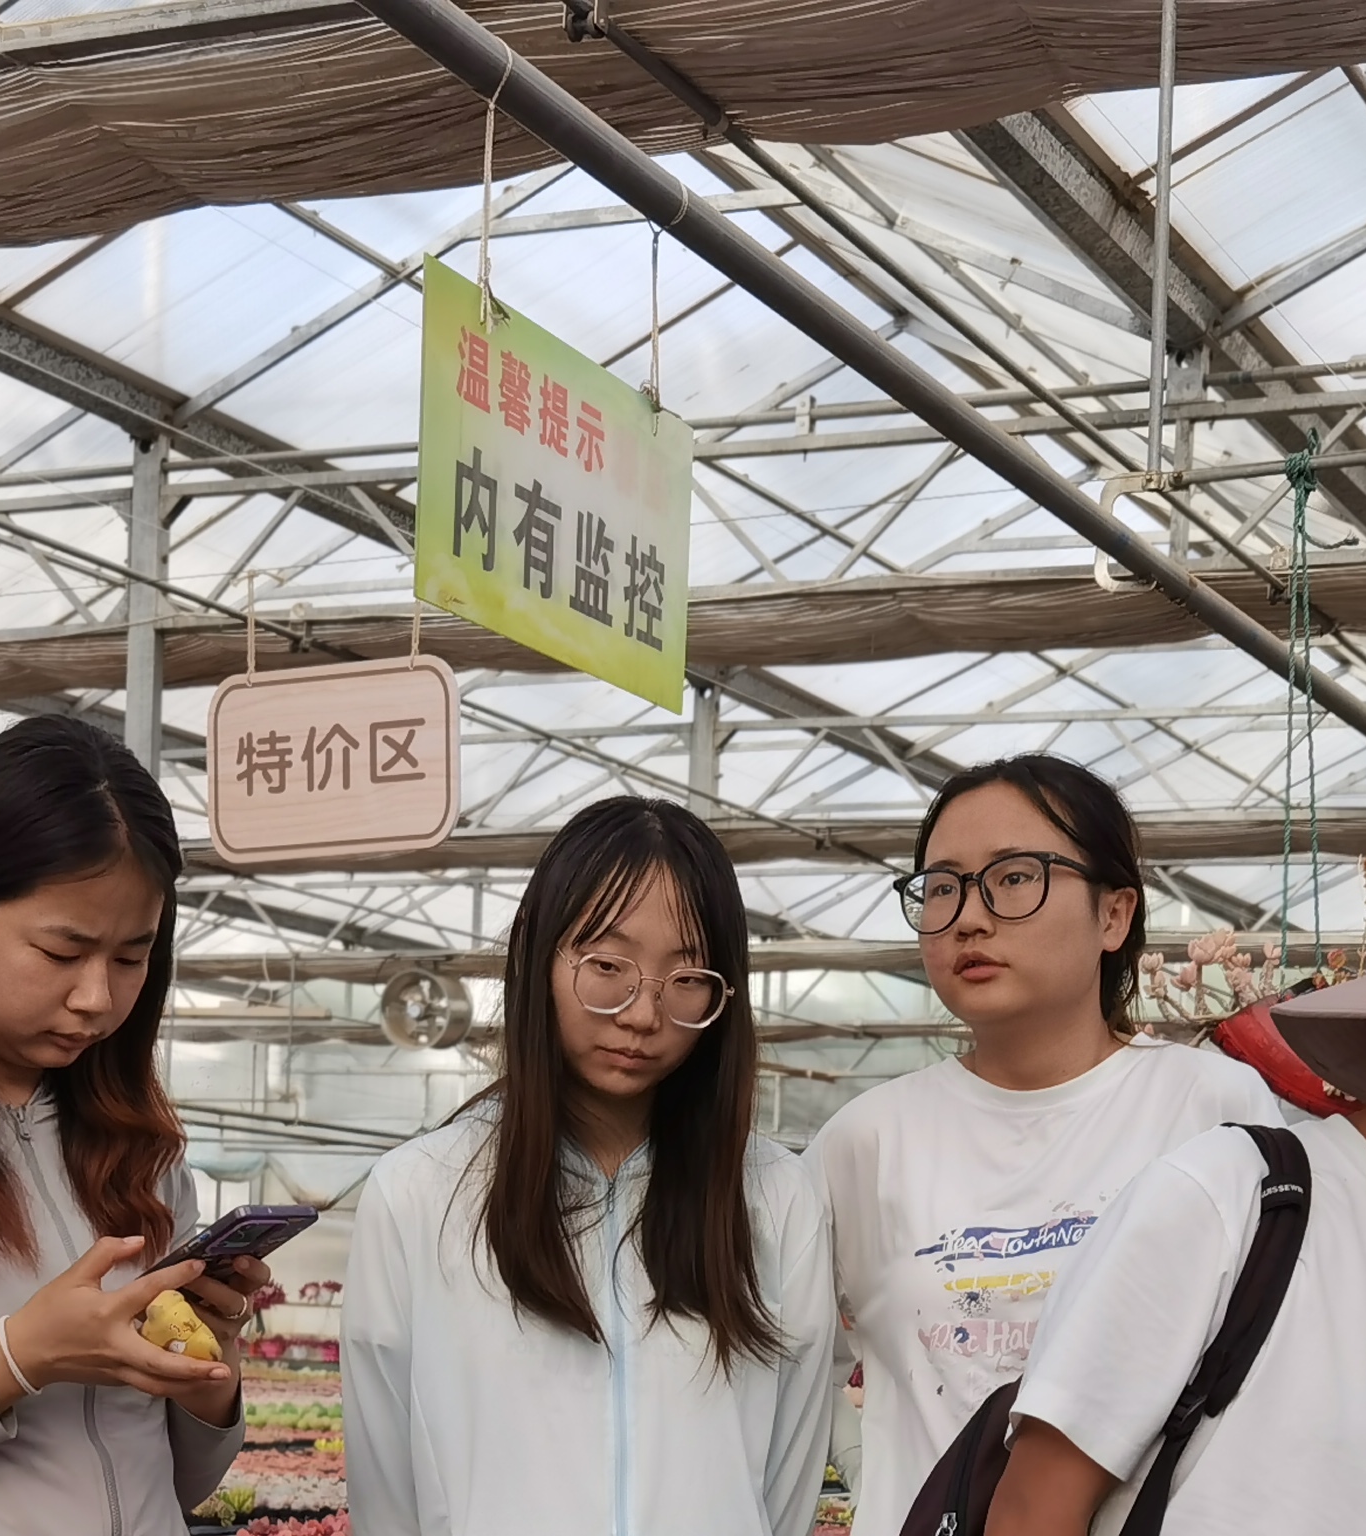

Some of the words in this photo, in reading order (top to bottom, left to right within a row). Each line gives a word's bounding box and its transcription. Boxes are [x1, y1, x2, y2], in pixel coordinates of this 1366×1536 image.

[456, 326, 605, 473] 温馨提示
[451, 446, 666, 653] 内有监控
[235, 717, 426, 797] 特价区
